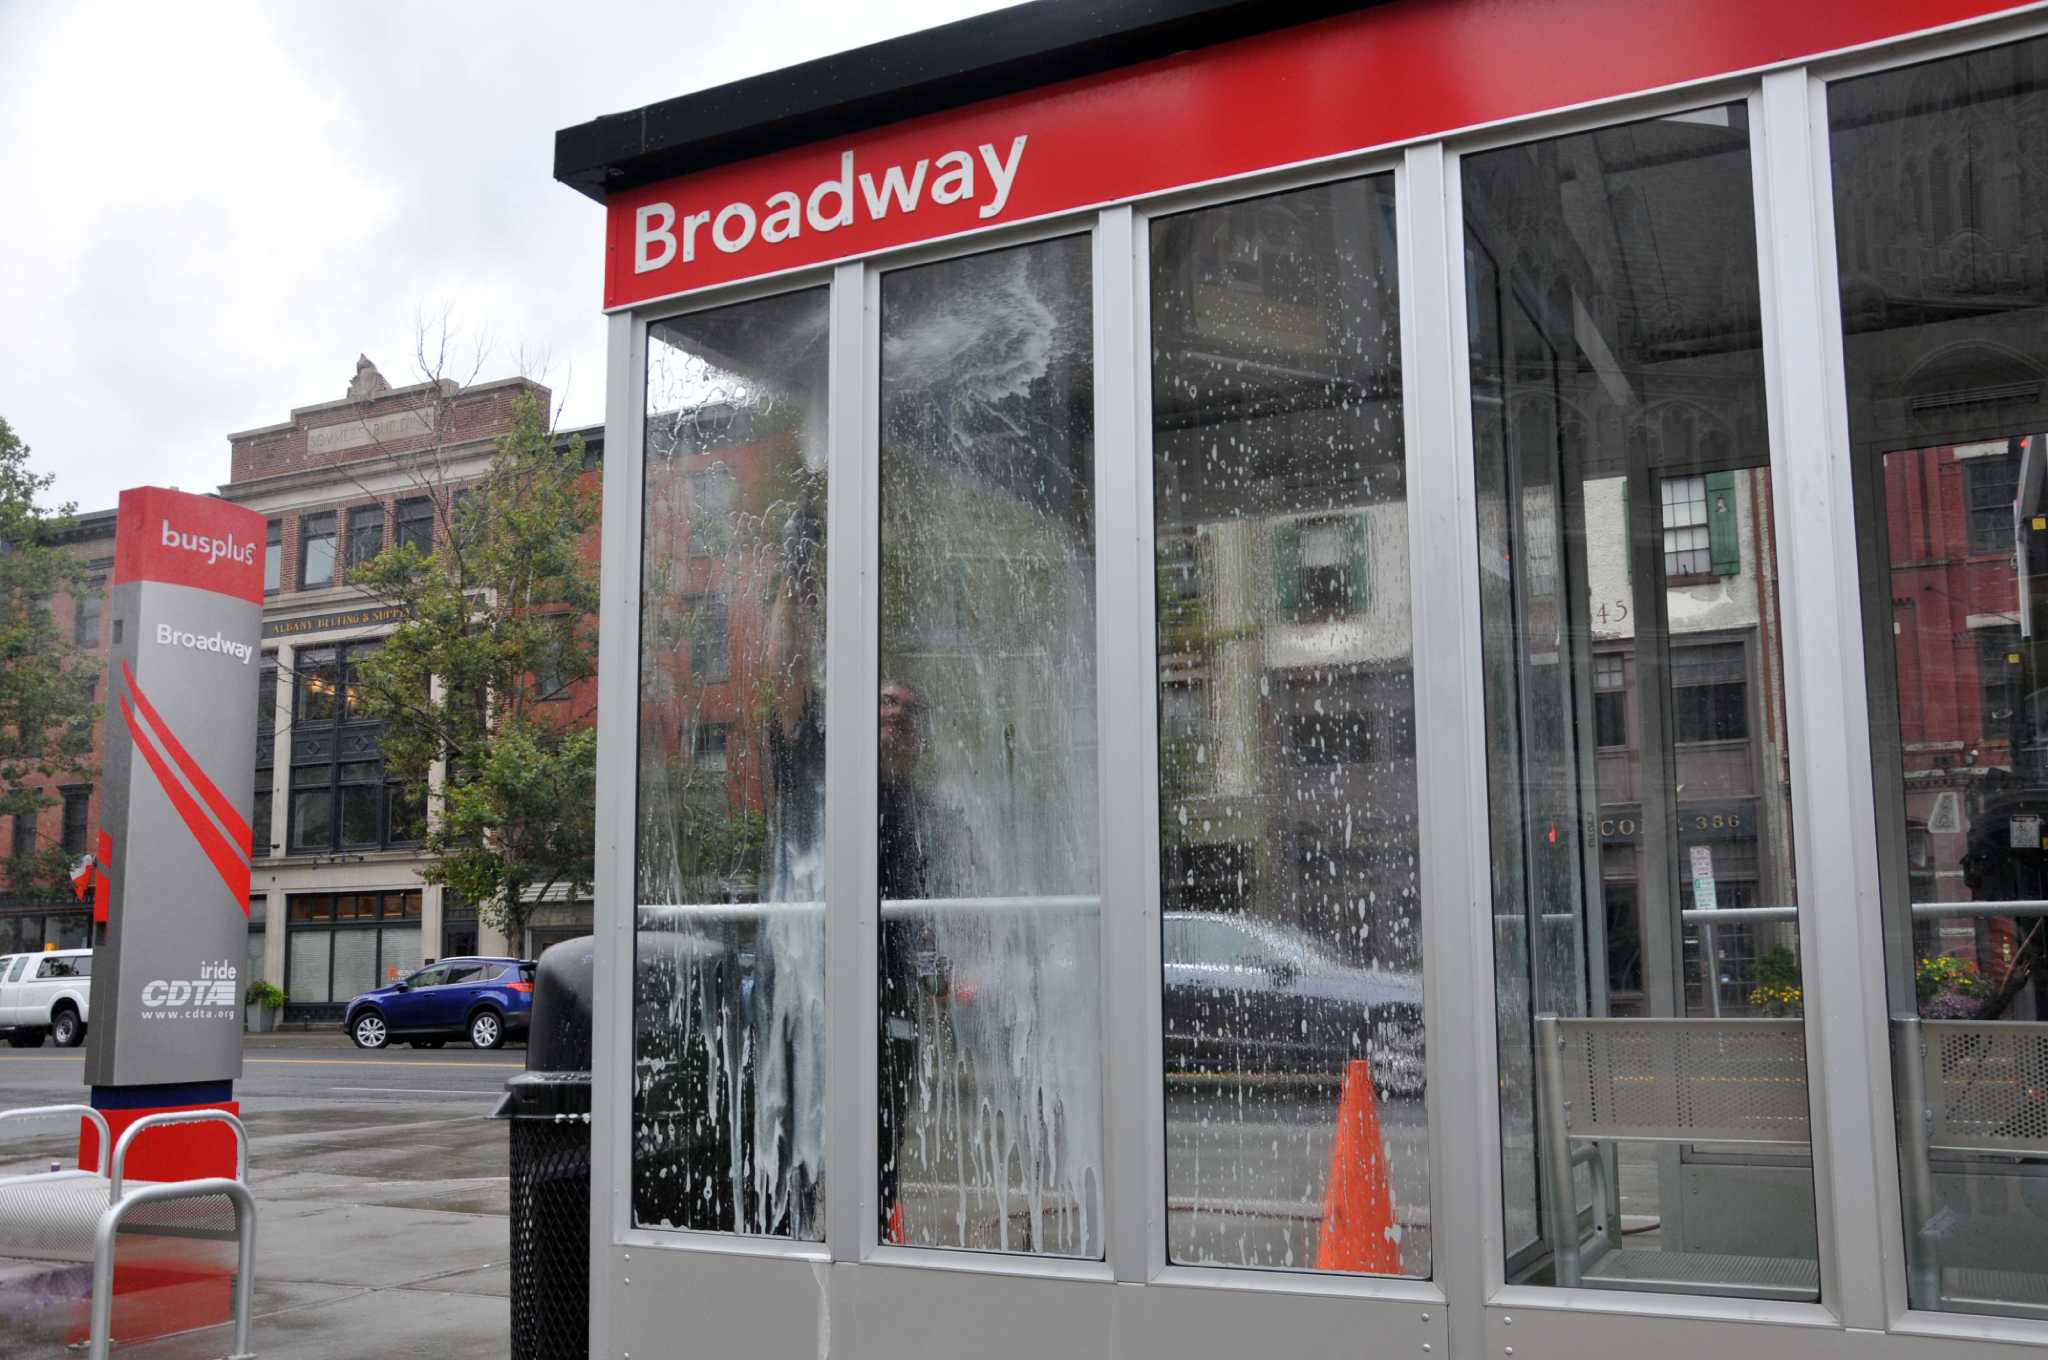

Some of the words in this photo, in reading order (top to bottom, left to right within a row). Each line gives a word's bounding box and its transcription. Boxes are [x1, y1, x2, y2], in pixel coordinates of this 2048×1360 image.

[634, 134, 1028, 275] Broadway
[161, 519, 257, 565] busplus
[271, 619, 313, 634] ALBANY
[156, 623, 253, 665] Broadway
[1695, 815, 1741, 830] 386
[200, 959, 237, 980] iride
[141, 980, 237, 1007] CDTA
[141, 1008, 235, 1020] www.cdta.org
